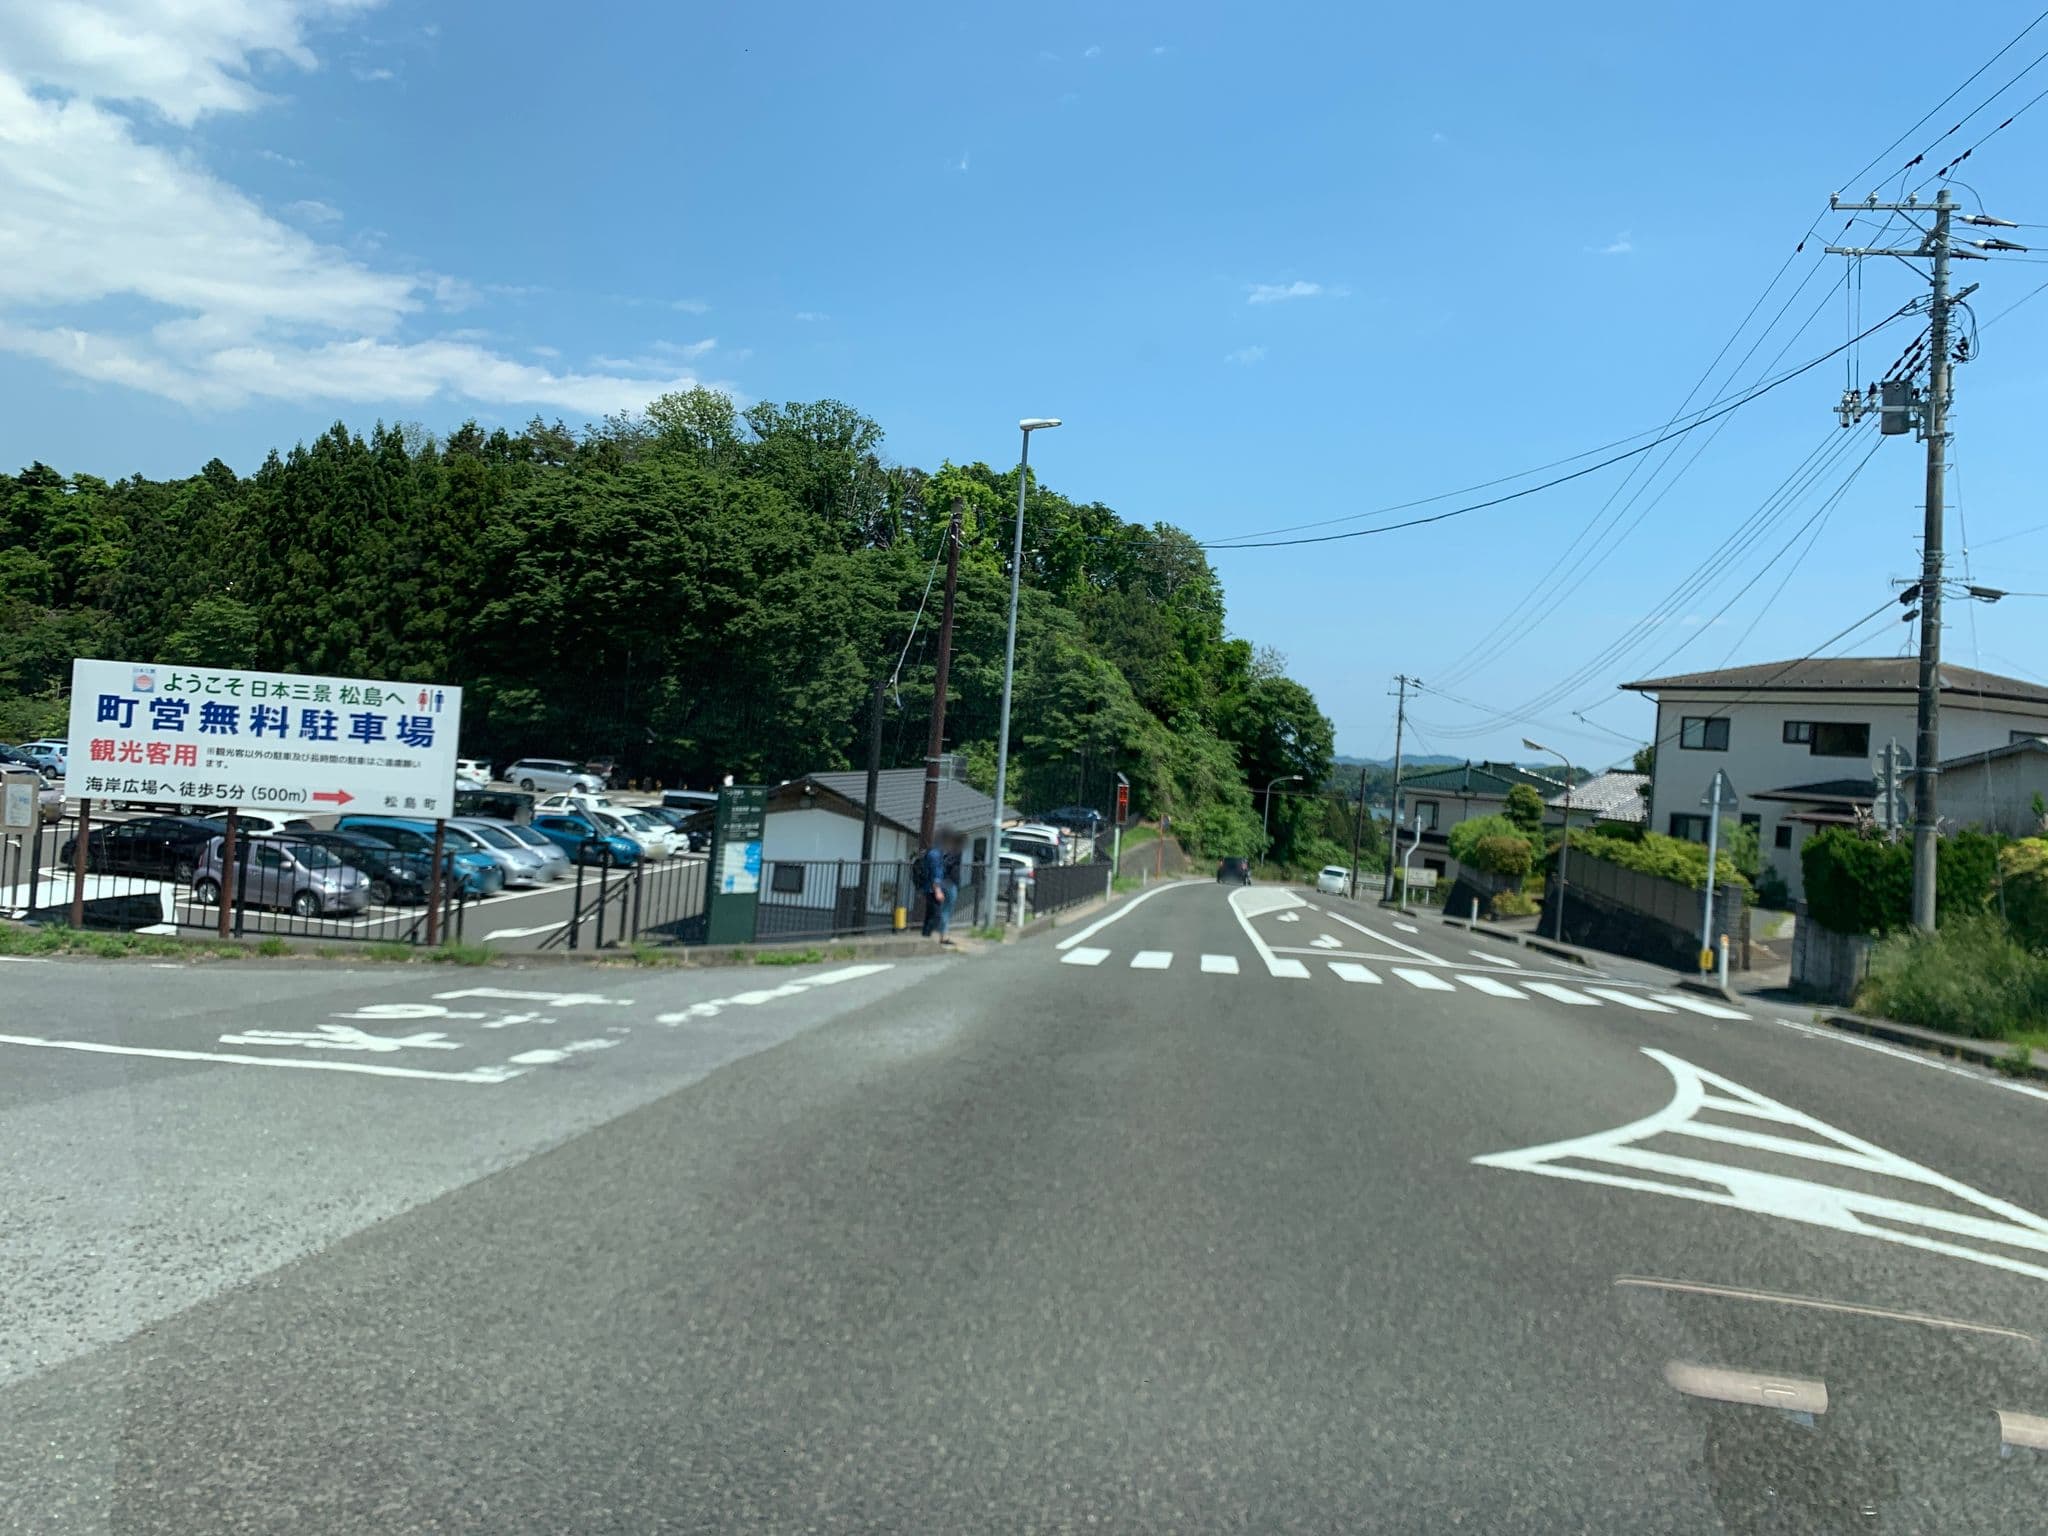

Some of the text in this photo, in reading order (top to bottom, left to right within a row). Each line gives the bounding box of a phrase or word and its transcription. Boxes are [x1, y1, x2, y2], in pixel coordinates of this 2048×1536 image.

[164, 672, 406, 707] ようこそ 日本三景 松島へ
[96, 693, 436, 749] 町営無料駐車場
[89, 737, 198, 768] 観光客用
[85, 775, 308, 804] 海岸広場へ 徒歩5分 (500m)
[384, 795, 438, 811] 松島町
